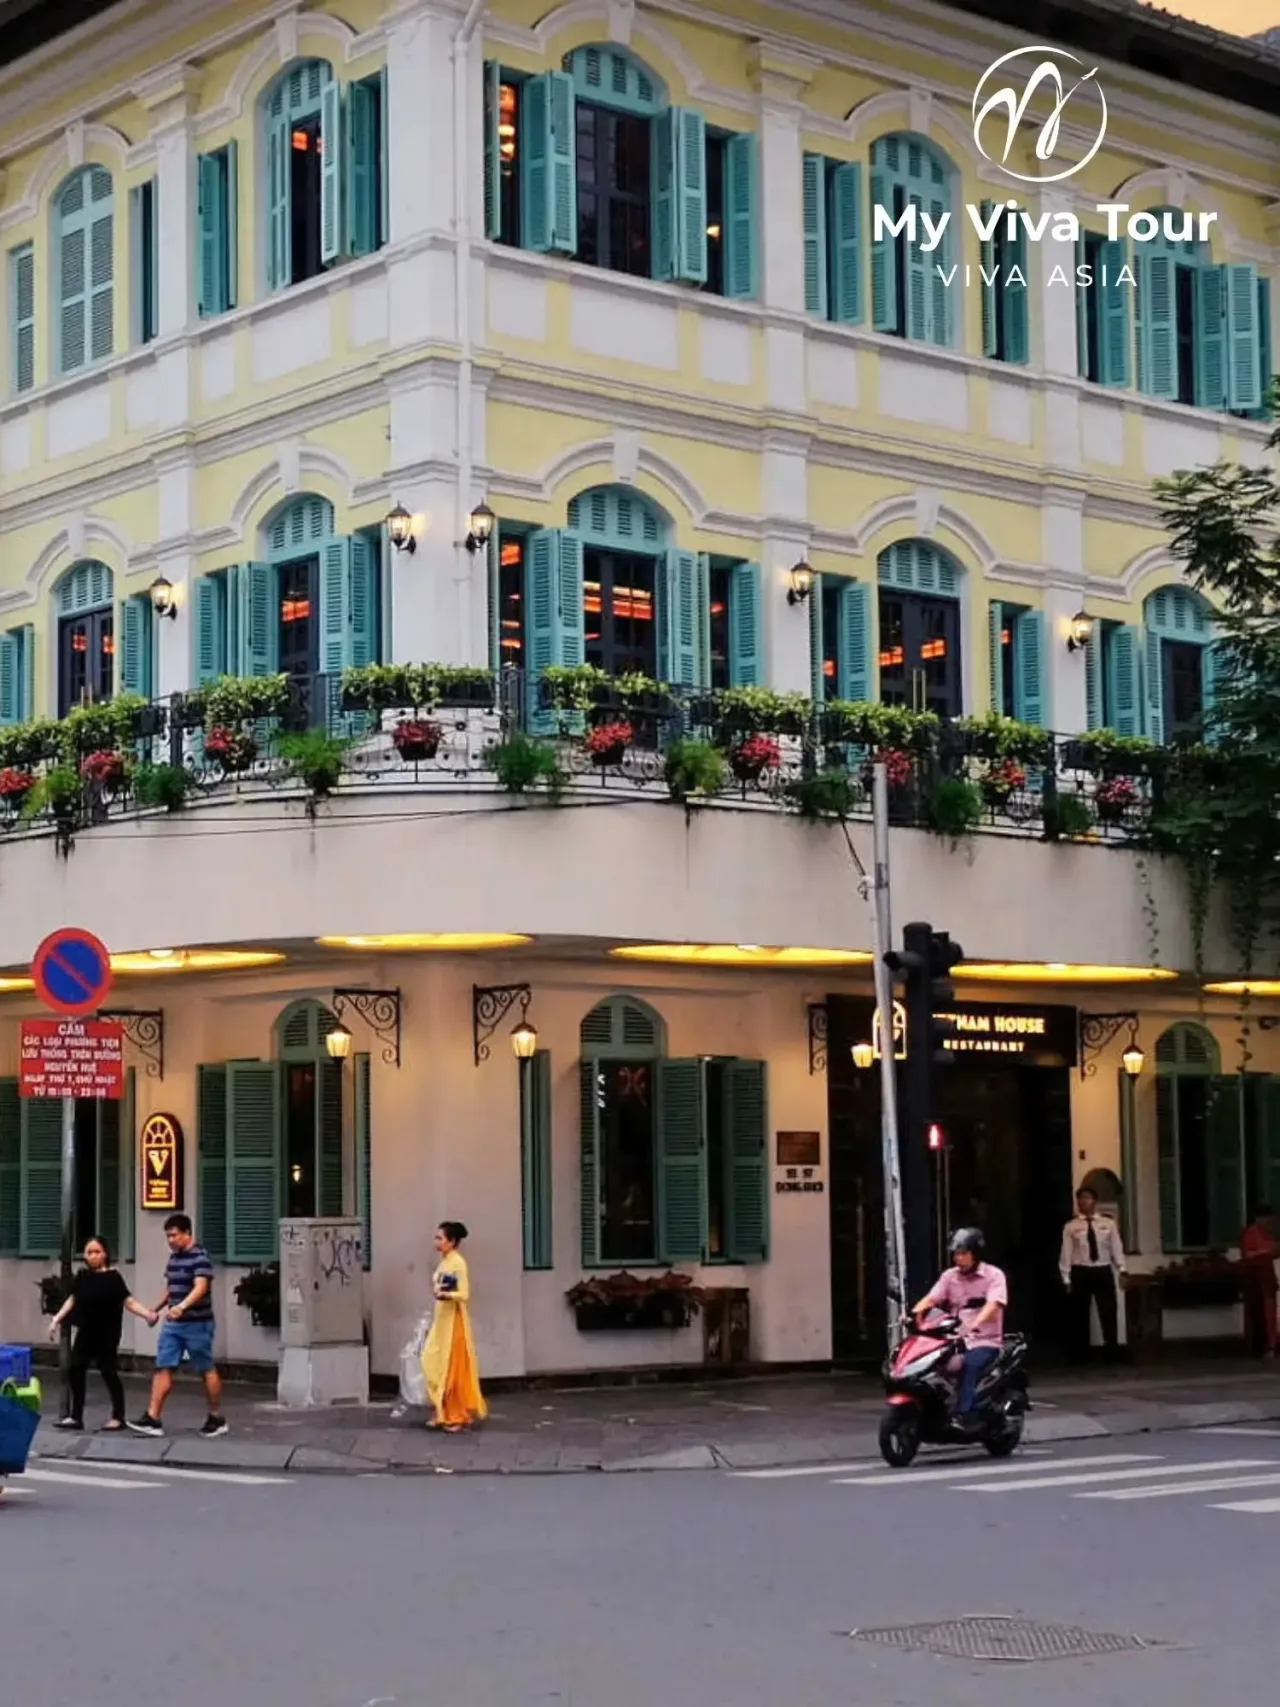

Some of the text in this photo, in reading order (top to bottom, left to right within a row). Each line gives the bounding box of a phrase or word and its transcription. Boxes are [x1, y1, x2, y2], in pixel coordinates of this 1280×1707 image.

[994, 1016, 1045, 1033] HOUSE
[943, 1039, 1024, 1052] RESTAURANT
[148, 1149, 169, 1177] V
